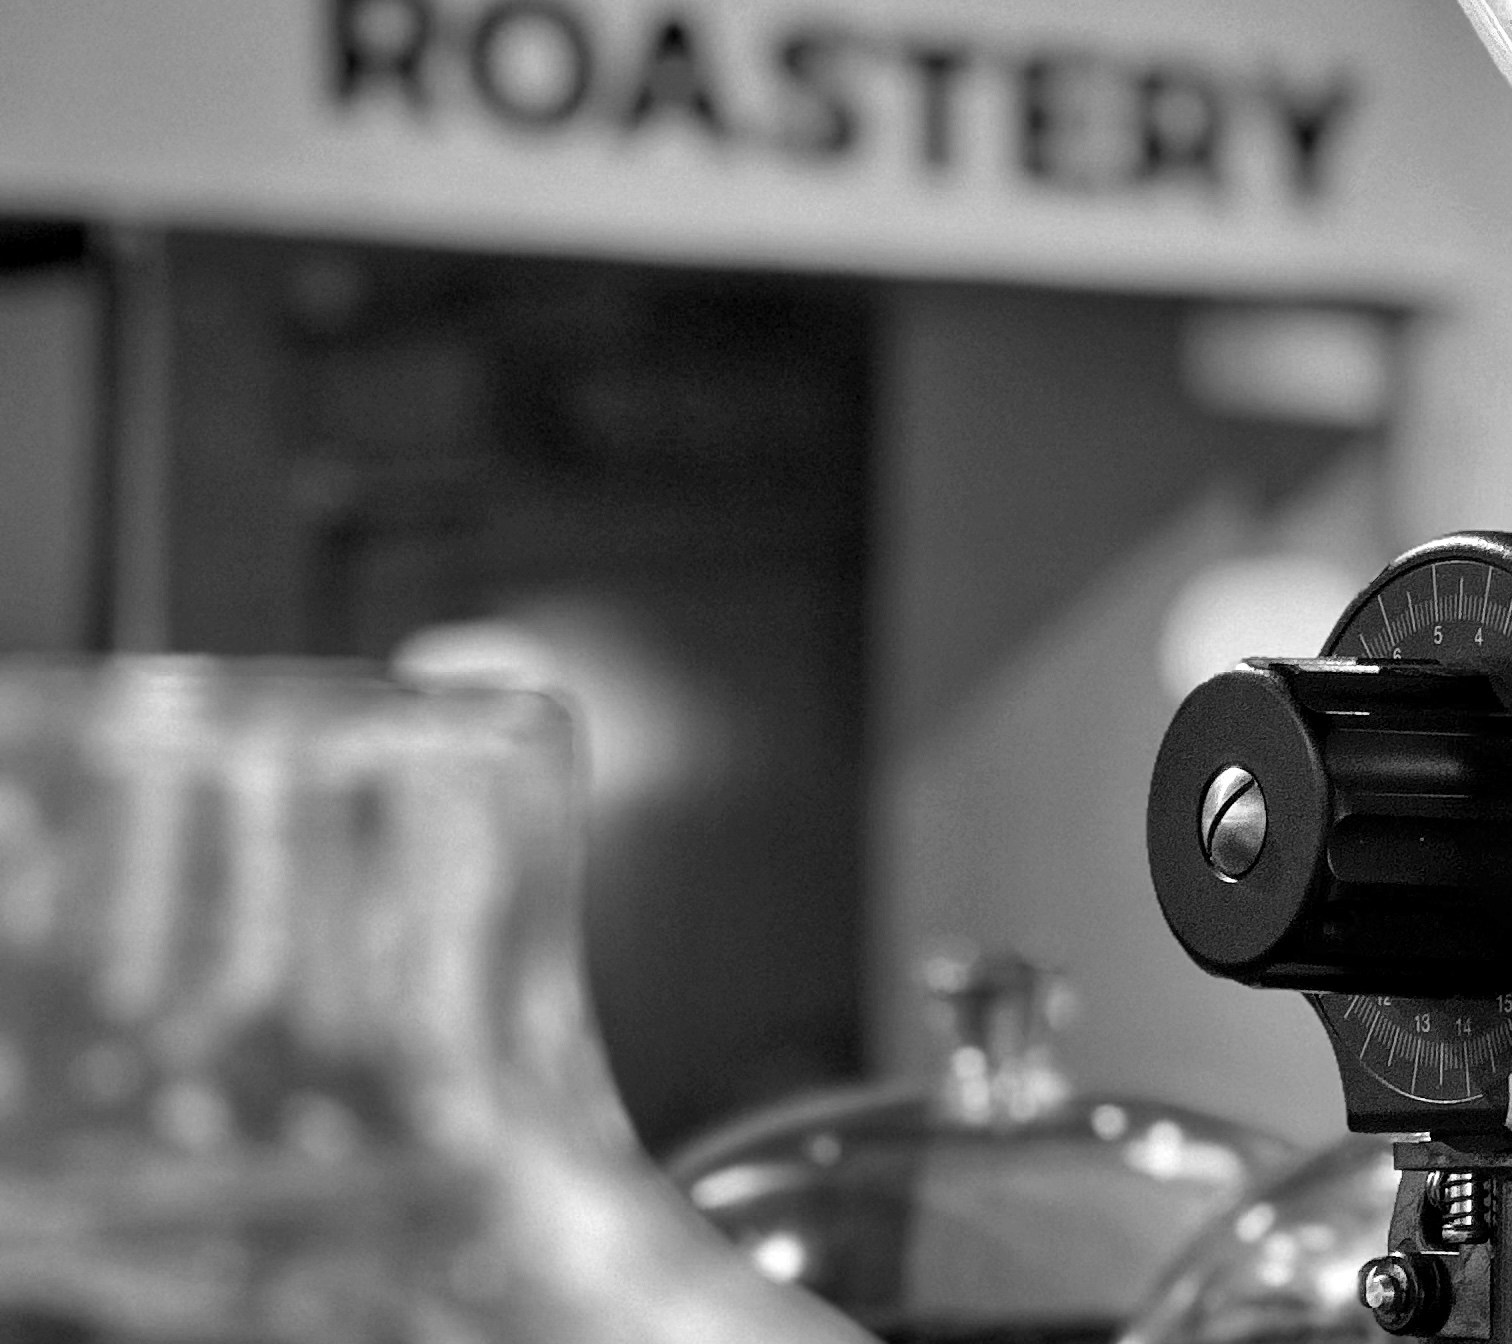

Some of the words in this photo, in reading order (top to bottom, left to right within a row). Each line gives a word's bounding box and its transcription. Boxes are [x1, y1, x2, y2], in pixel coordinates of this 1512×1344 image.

[1433, 625, 1443, 645] 5
[1473, 626, 1484, 646] 4
[1496, 993, 1512, 1013] 15
[1414, 1013, 1431, 1034] 13
[1455, 1016, 1472, 1036] 14
